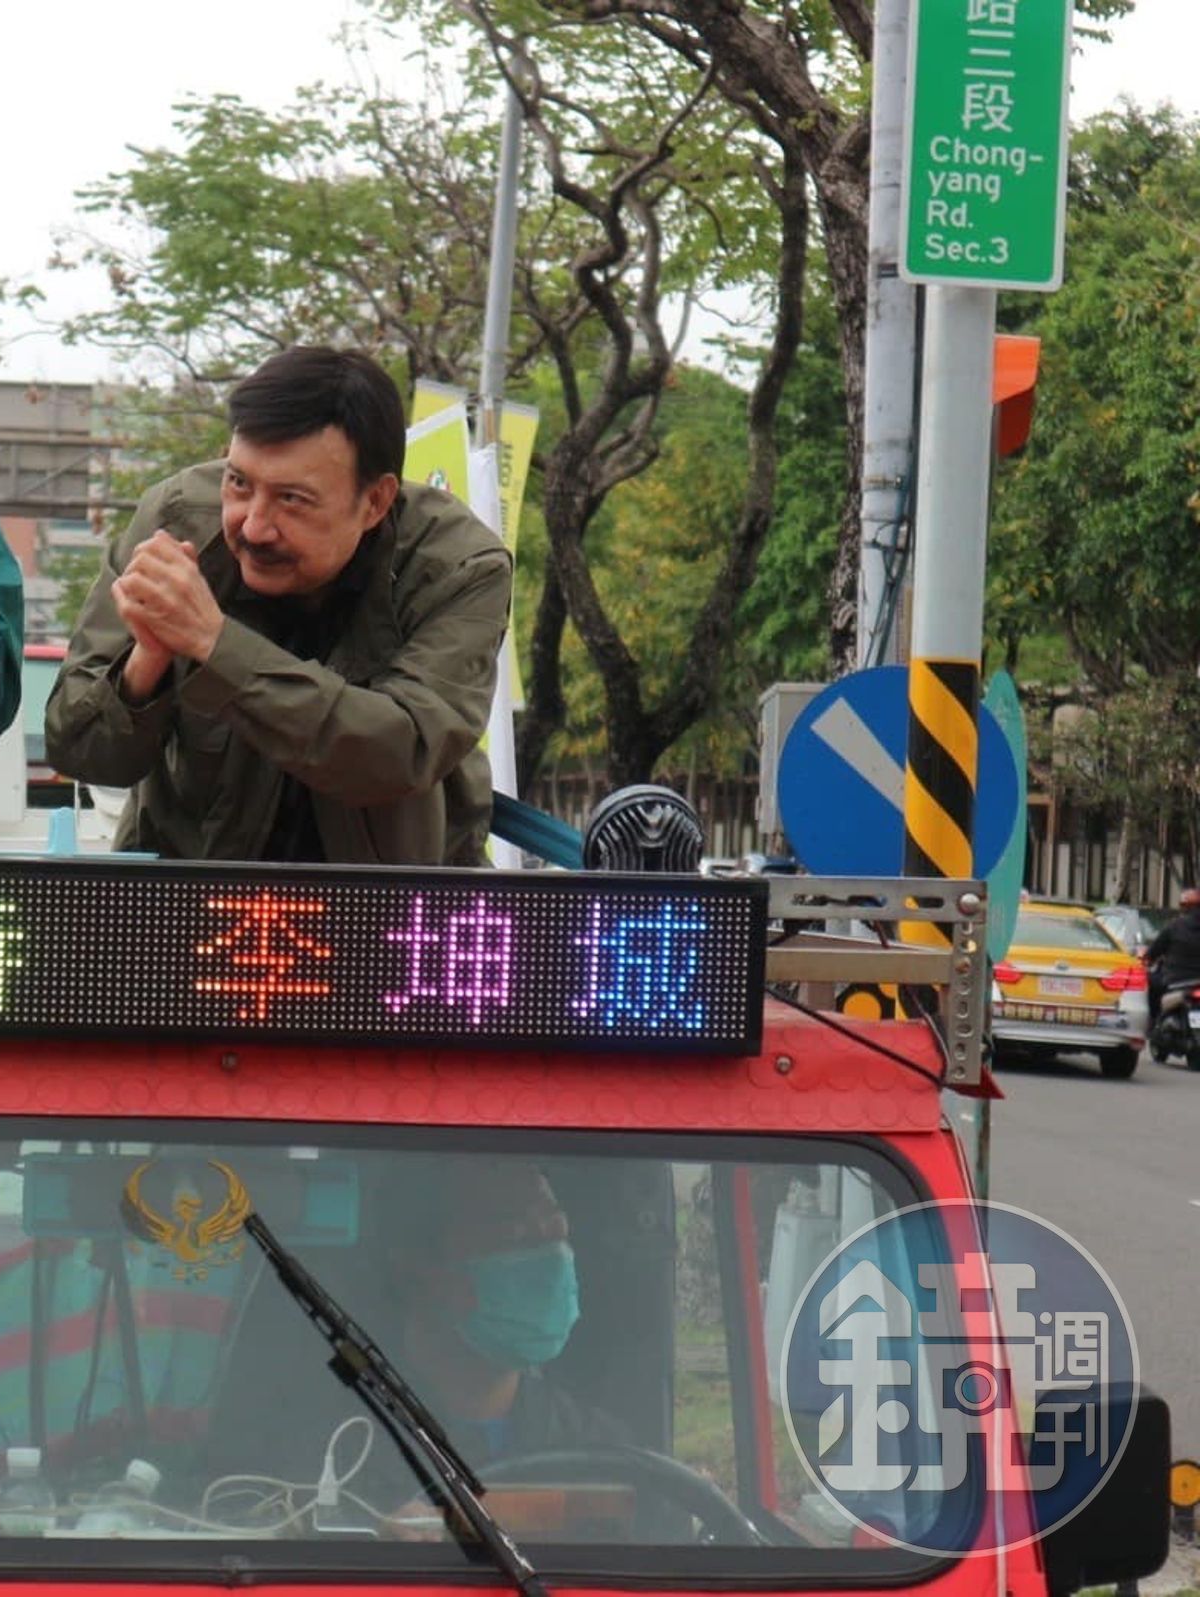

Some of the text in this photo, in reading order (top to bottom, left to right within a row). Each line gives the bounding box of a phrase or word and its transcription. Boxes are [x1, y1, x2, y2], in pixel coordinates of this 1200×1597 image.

[929, 136, 1043, 175] Chong-
[928, 170, 1002, 202] yang
[926, 201, 974, 228] Rd.
[924, 234, 1009, 264] Sec.3
[193, 886, 710, 1032] 李坤城
